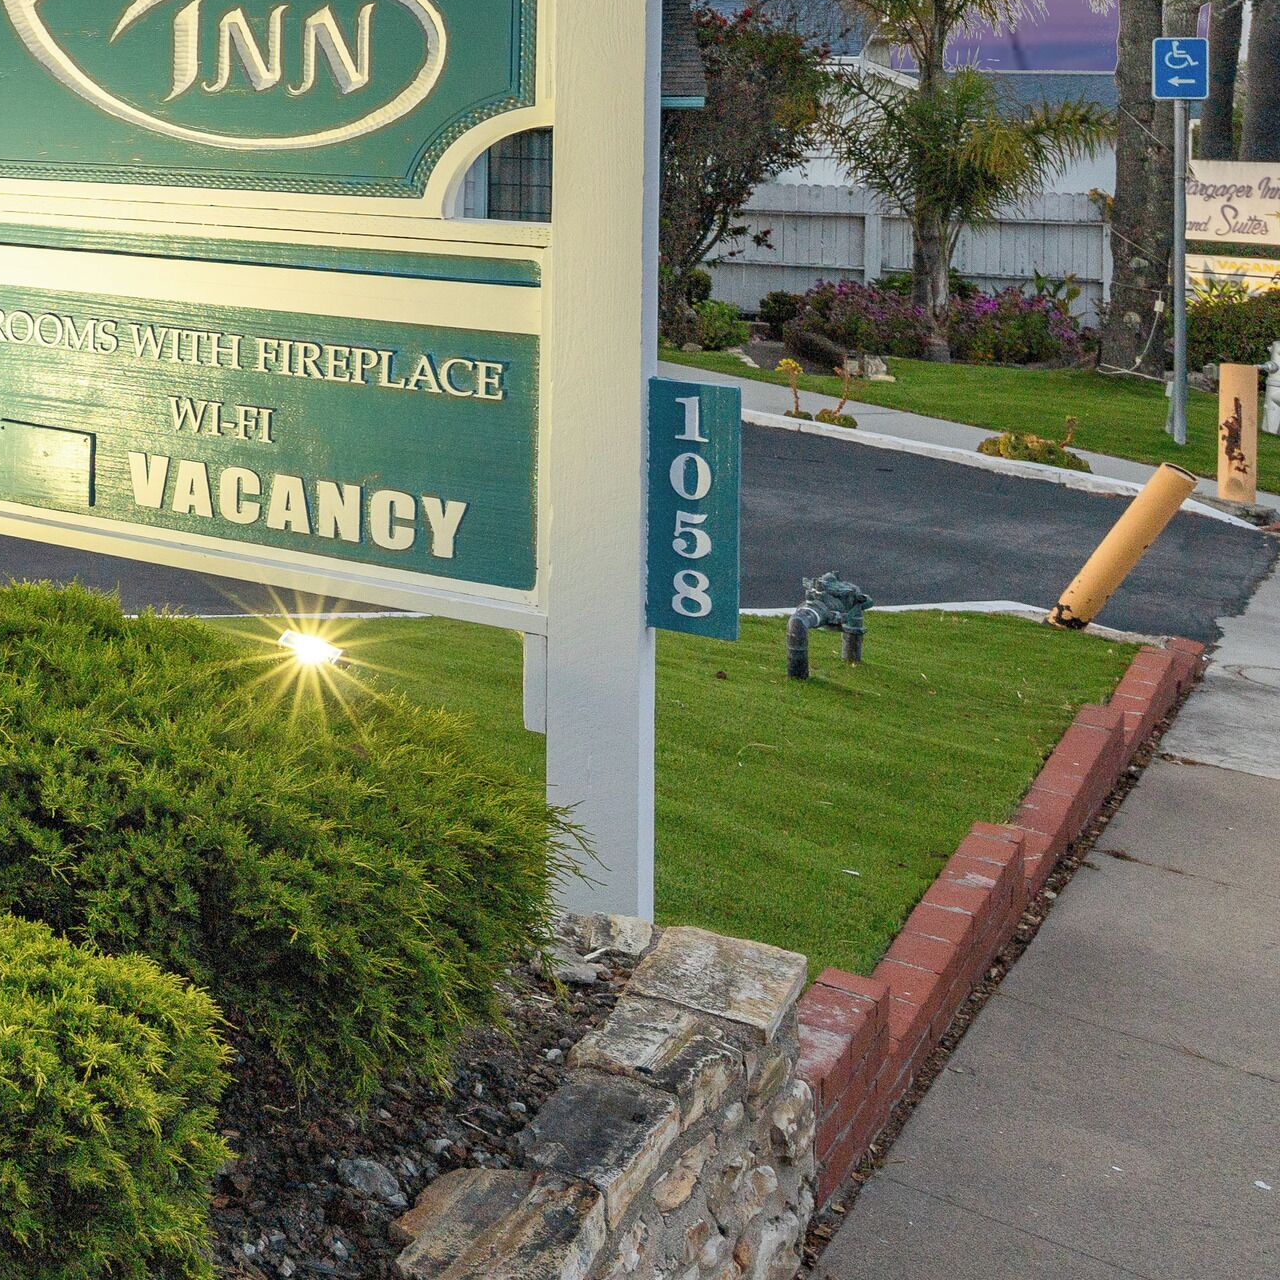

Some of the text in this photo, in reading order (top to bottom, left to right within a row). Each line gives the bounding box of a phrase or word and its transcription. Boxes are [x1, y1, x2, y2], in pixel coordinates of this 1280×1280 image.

[1215, 204, 1269, 236] Suites
[1217, 260, 1280, 274] VACAN
[127, 323, 244, 371] WITH
[254, 336, 506, 401] FIREPLACE
[168, 395, 276, 443] WI-FI
[128, 451, 468, 559] VACANCY
[669, 396, 713, 618] 1058
